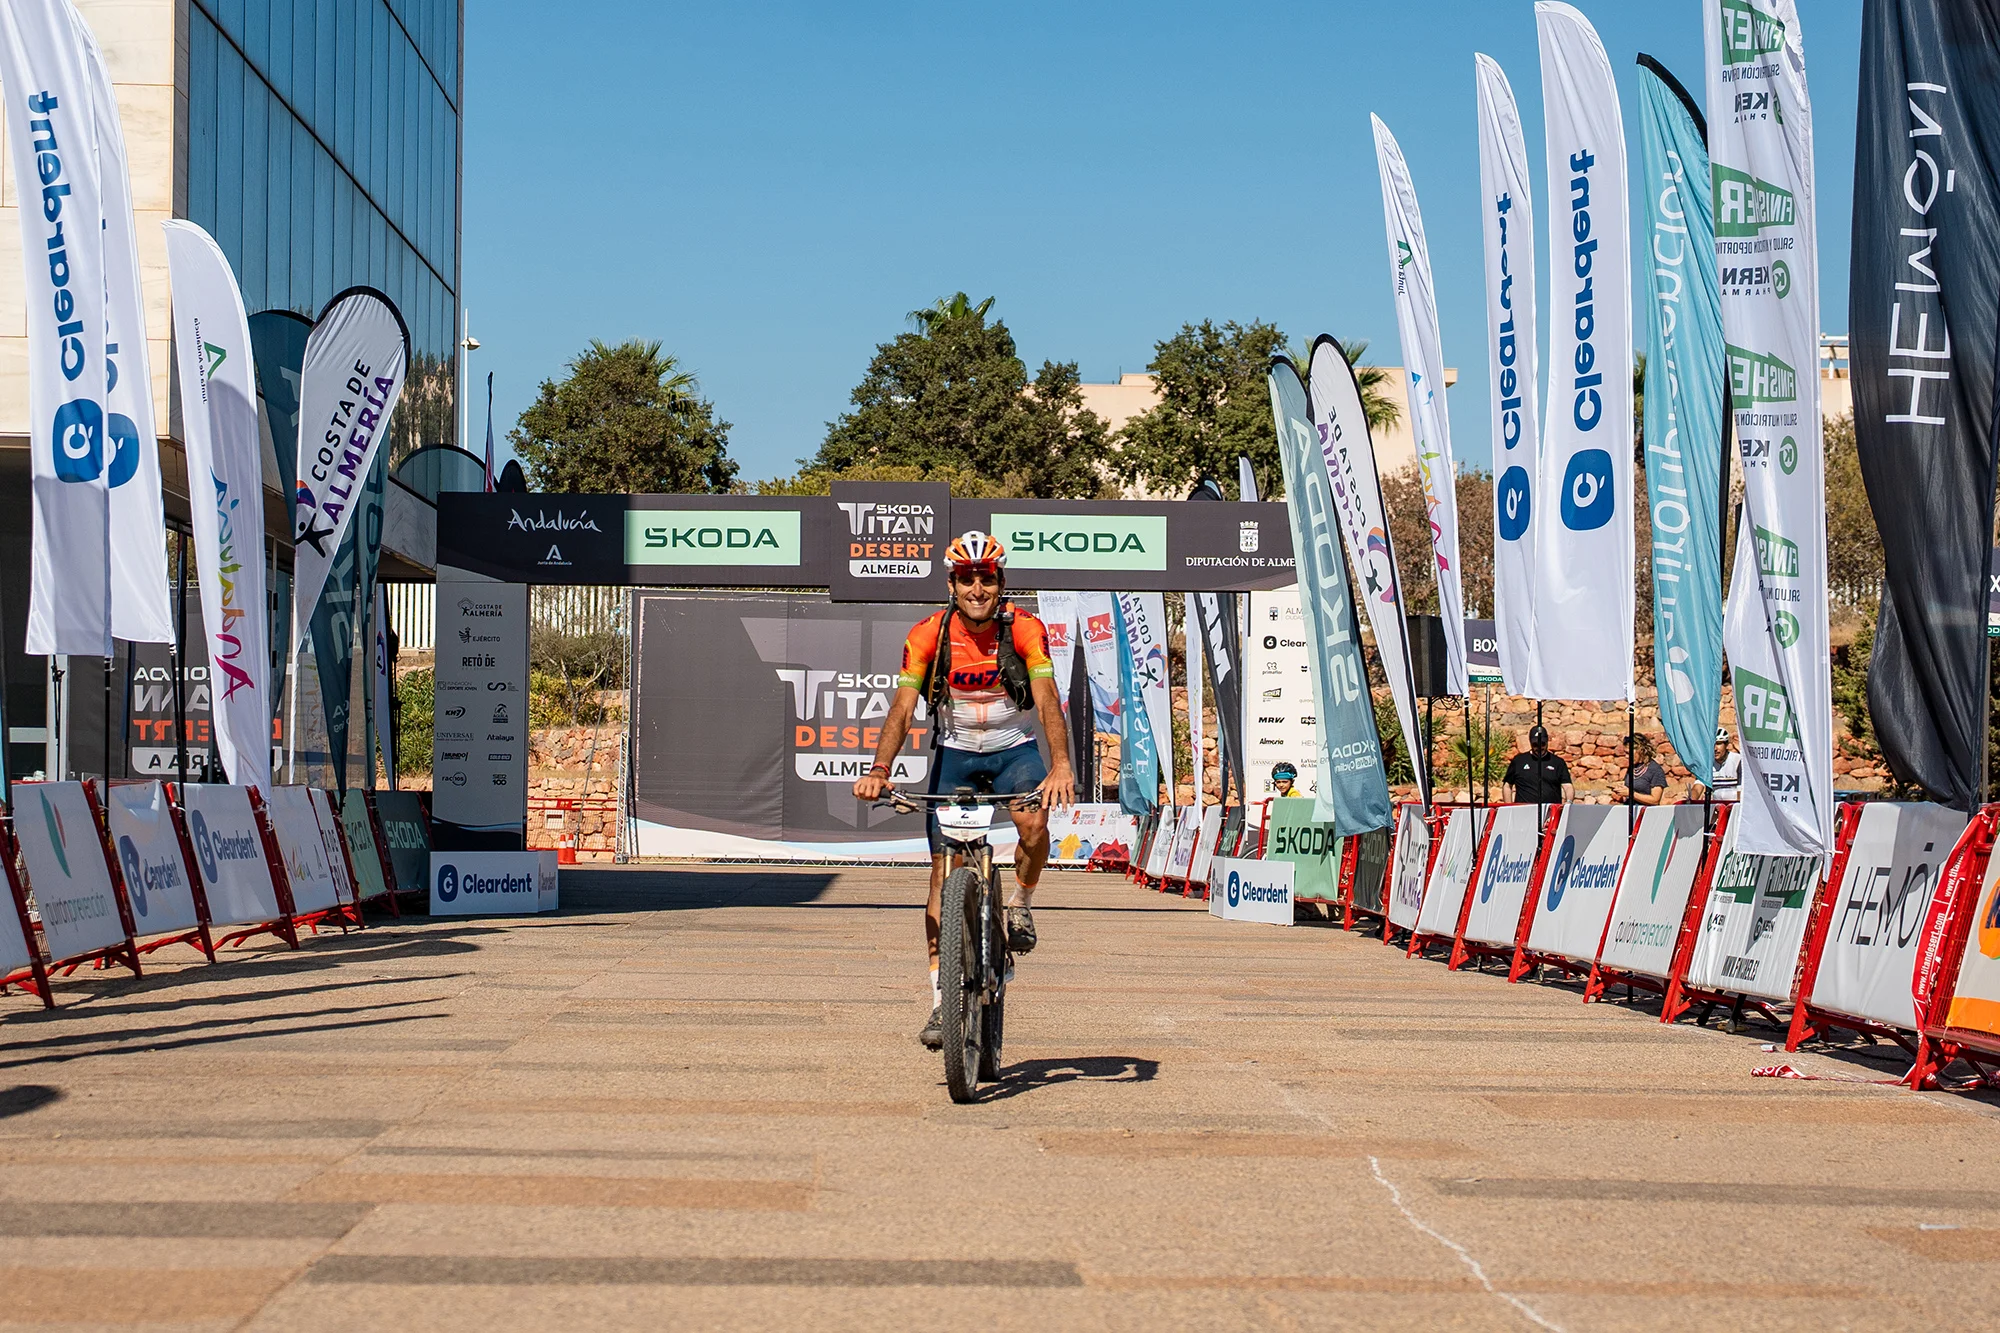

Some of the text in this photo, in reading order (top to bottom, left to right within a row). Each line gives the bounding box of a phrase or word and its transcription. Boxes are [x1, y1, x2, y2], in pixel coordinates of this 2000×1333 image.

[311, 399, 356, 482] COSTA
[346, 358, 371, 397] DE
[321, 376, 394, 526] ALMERÍA
[507, 508, 602, 533] Andalucía
[837, 502, 934, 536] TITAN
[876, 504, 935, 515] SKODA
[644, 527, 779, 548] SKODA
[1011, 531, 1146, 553] SKODA
[850, 543, 934, 558] DESERT
[1185, 556, 1249, 567] DIPUTACIÓN
[1252, 557, 1265, 567] DE
[860, 562, 920, 574] ALMERÍA
[1280, 639, 1308, 647] Clear
[487, 734, 514, 742] Atalaya
[795, 725, 928, 750] DESET
[813, 761, 909, 778] ALMEA
[212, 830, 257, 861] Cleardent
[384, 820, 426, 849] SKODA
[1275, 827, 1336, 857] SKODA
[1497, 852, 1532, 883] Cleardent
[1570, 855, 1620, 889] Cleardent
[463, 872, 532, 894] Cleardent
[1242, 881, 1288, 904] Cleardent
[1917, 912, 1946, 995] www.titandesert.com
